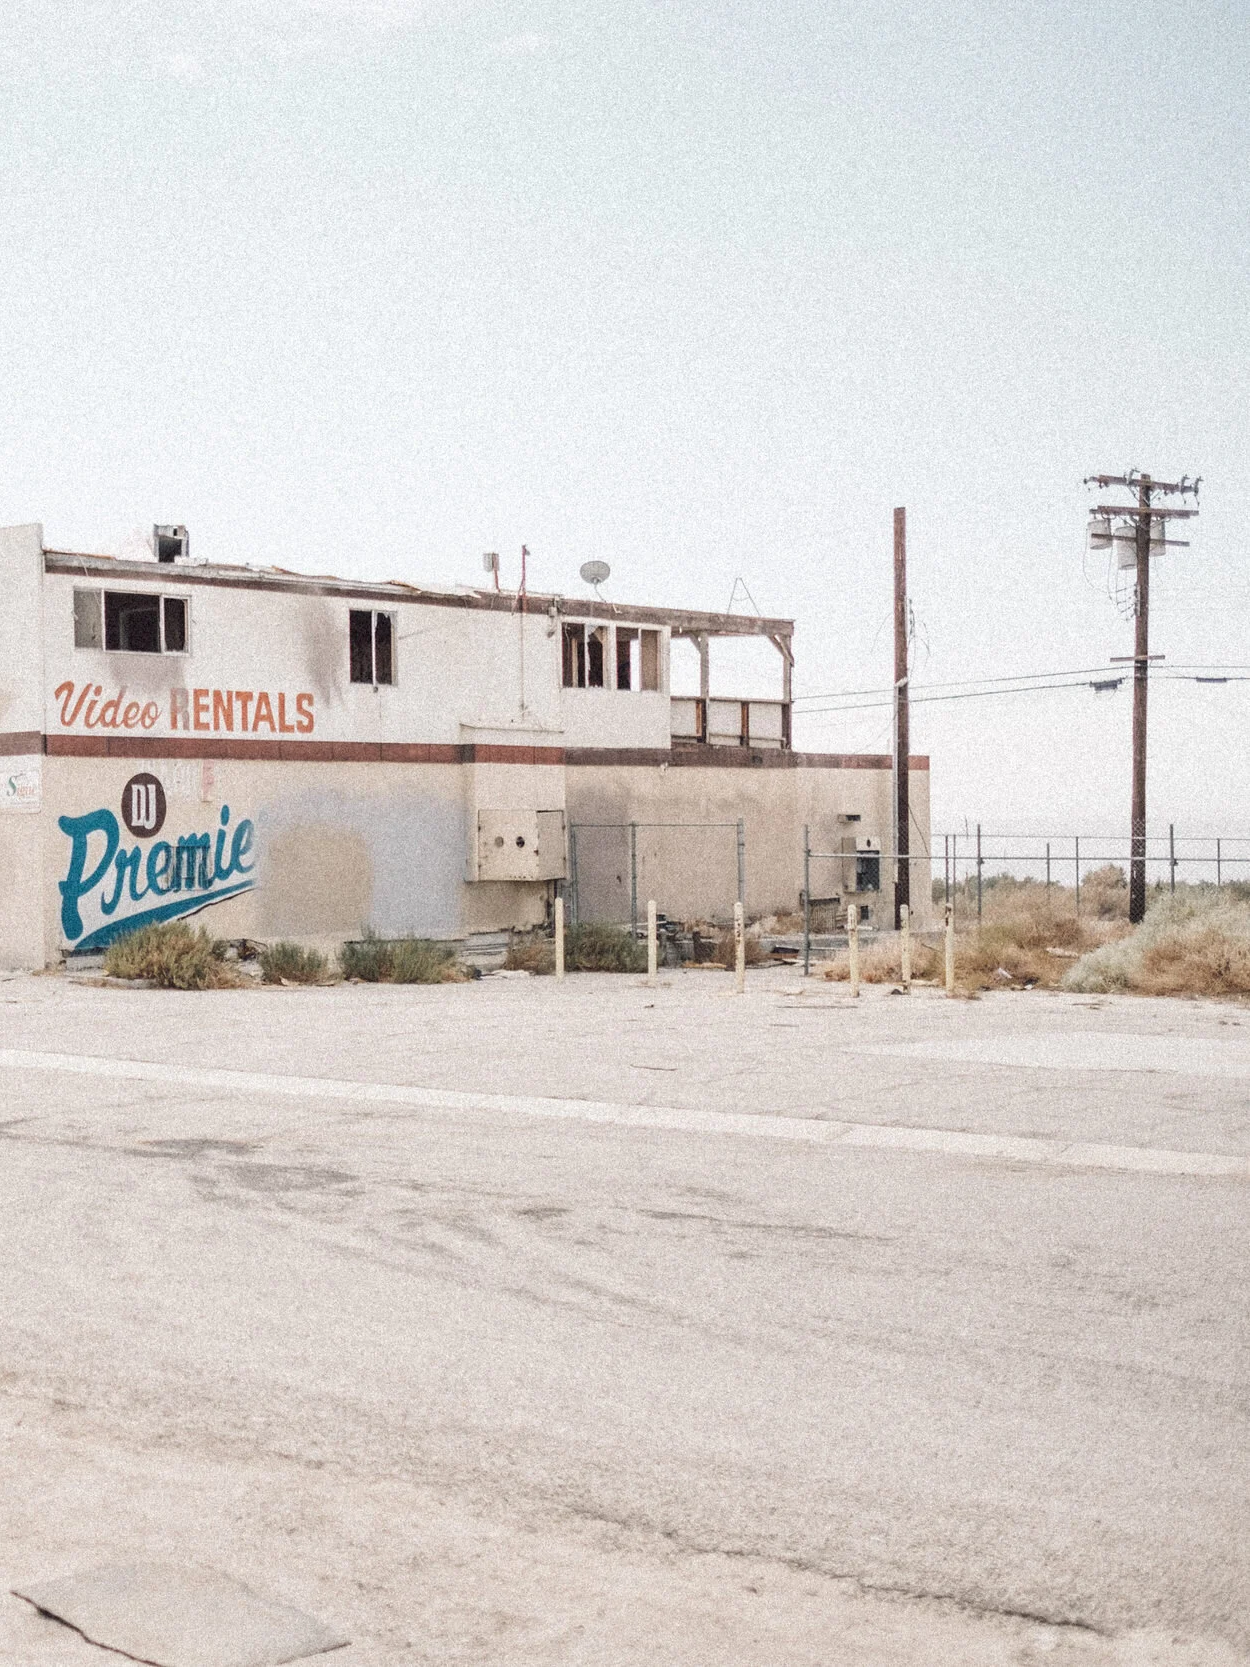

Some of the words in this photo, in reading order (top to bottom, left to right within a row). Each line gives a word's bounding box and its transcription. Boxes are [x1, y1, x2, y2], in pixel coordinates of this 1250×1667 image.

[54, 680, 162, 729] Video
[170, 687, 315, 734] RENTALS
[130, 783, 157, 830] DJ
[57, 804, 256, 941] Premie
